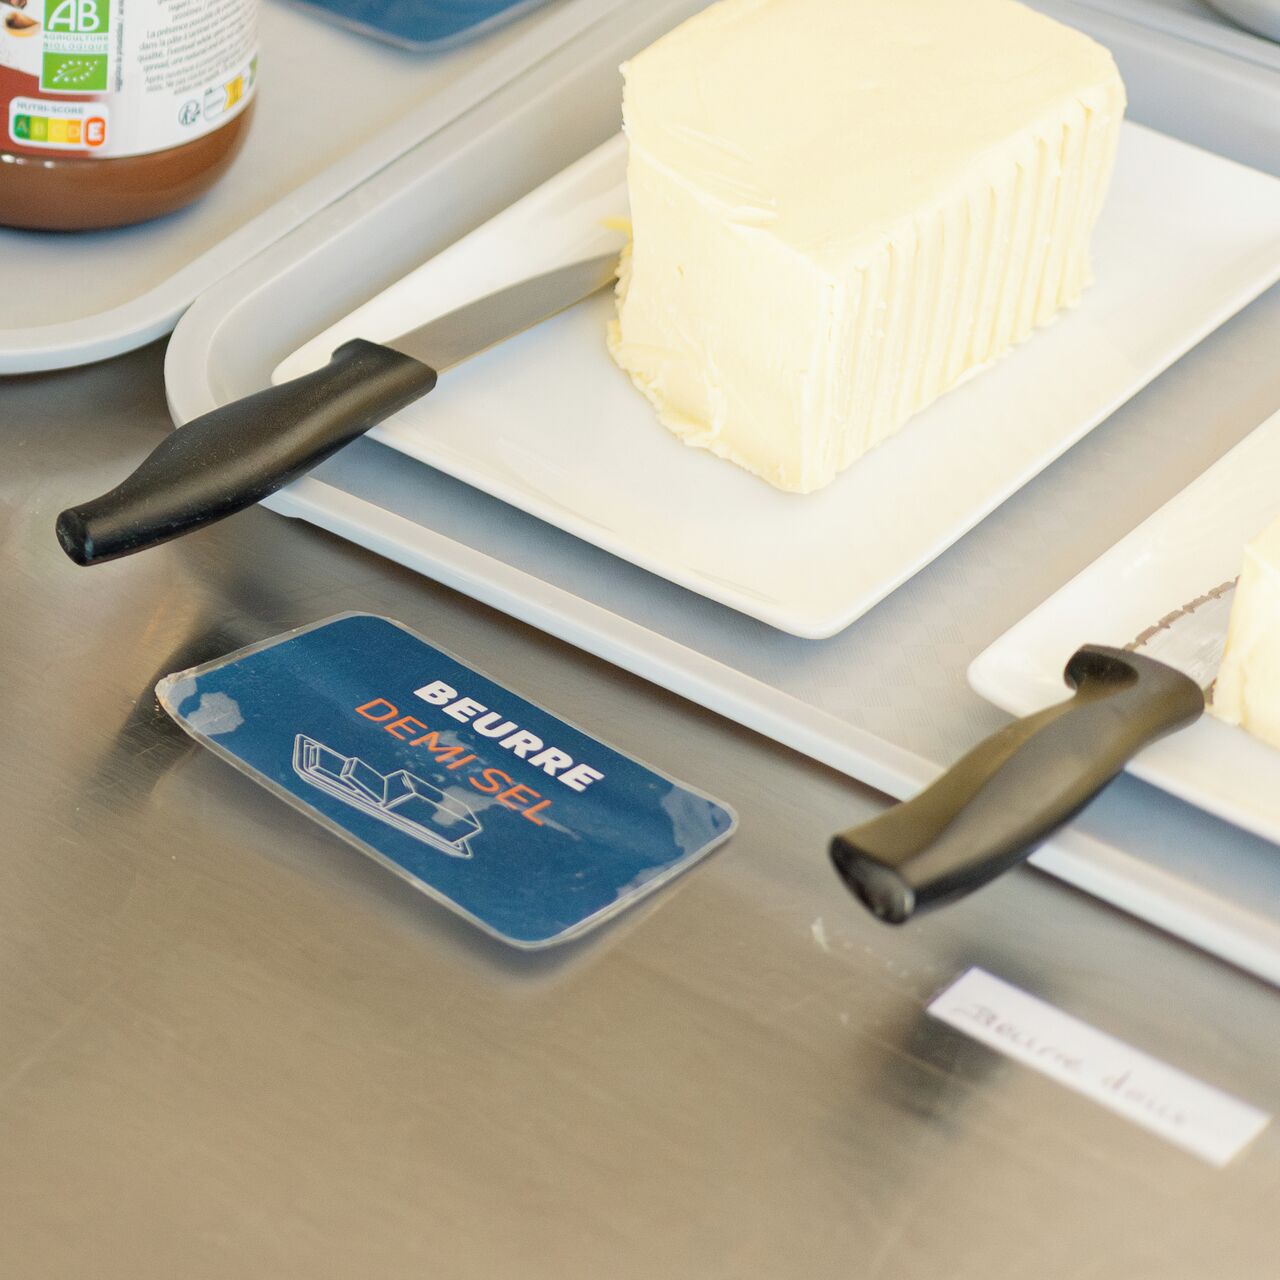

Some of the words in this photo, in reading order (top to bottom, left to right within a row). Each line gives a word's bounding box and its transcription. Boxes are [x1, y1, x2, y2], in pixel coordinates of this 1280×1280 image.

[16, 101, 85, 116] NUTRI-SCORE
[88, 121, 103, 141] E
[354, 697, 474, 770] DEMI
[468, 768, 553, 827] SEL
[413, 680, 605, 793] BEURRE
